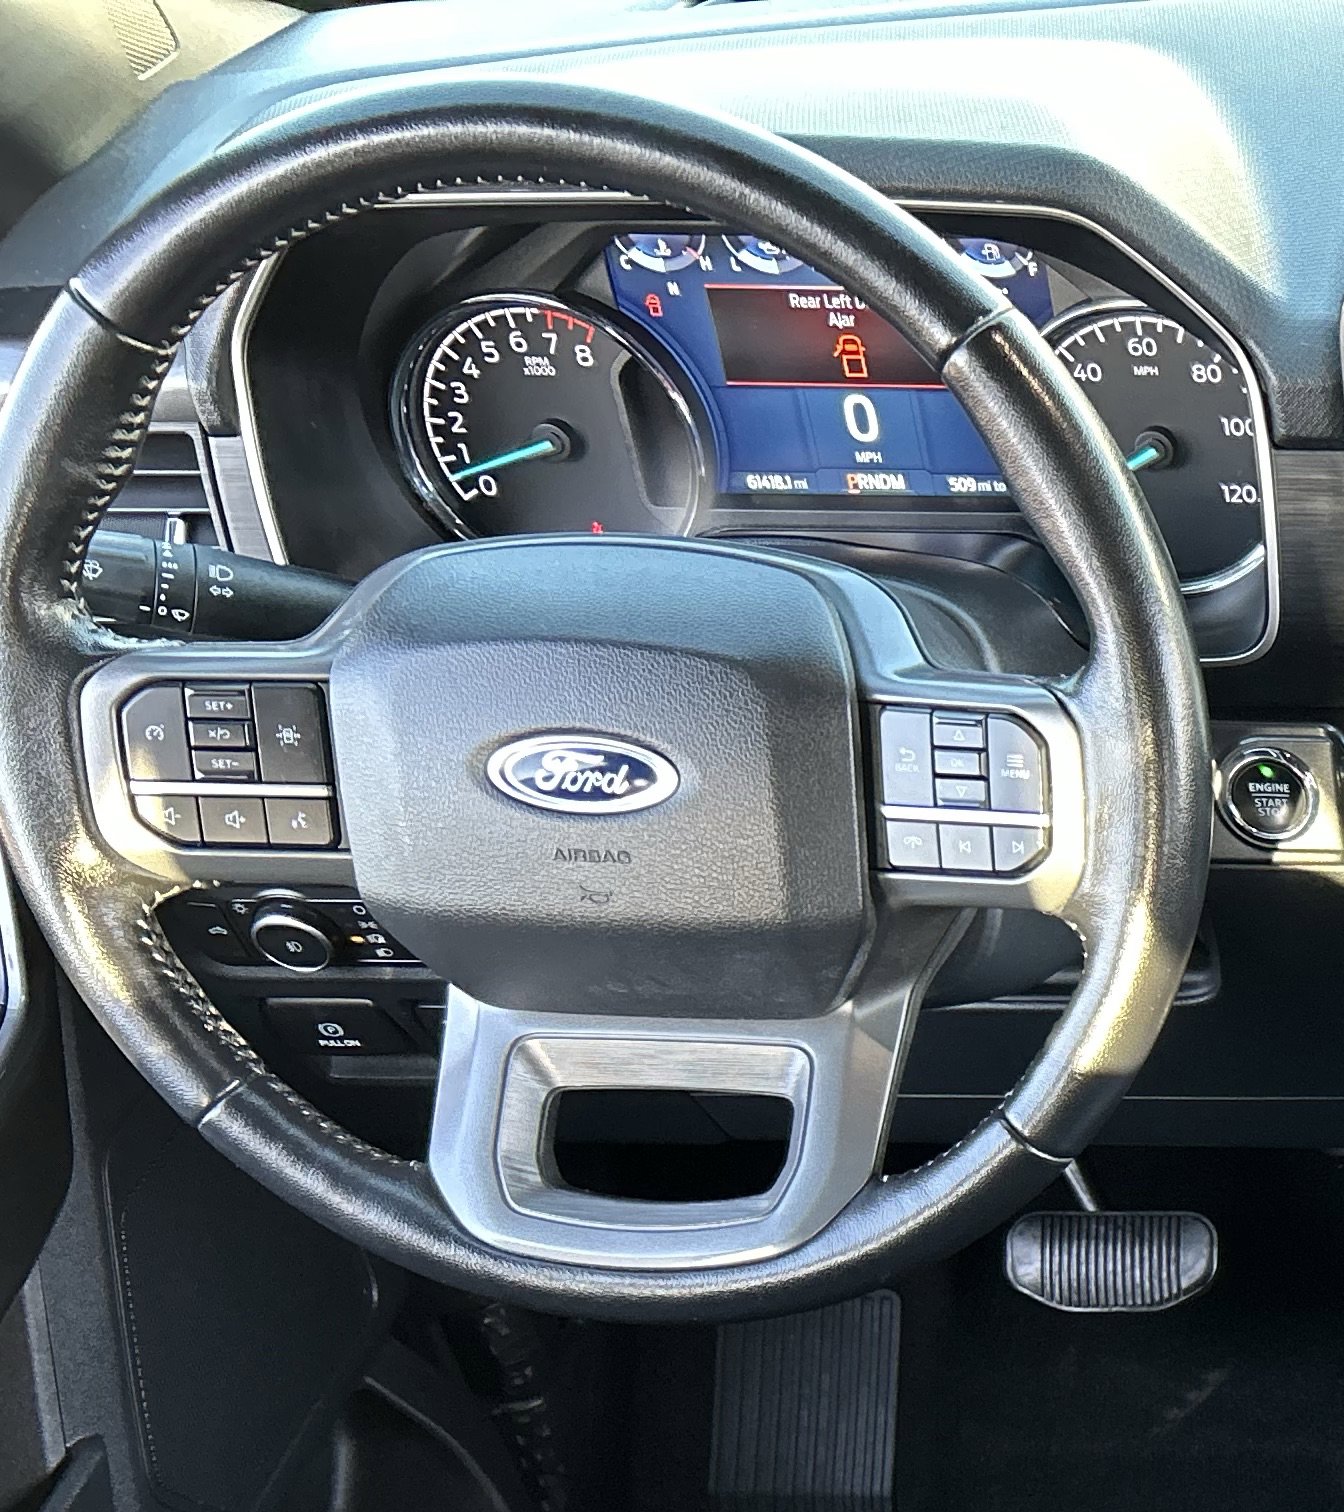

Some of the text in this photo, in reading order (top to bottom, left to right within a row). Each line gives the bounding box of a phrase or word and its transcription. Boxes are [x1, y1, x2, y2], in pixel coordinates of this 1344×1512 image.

[789, 293, 820, 309] Rear
[823, 293, 853, 309] Left
[829, 311, 855, 329] Ajar
[509, 331, 528, 352] 6
[542, 332, 558, 354] 7
[1127, 337, 1158, 357] 60
[480, 341, 500, 363] 5
[523, 355, 550, 367] RPM
[574, 344, 594, 367] 8
[462, 357, 481, 379] 4
[523, 366, 556, 377] x1000
[1073, 363, 1103, 382] 40
[1133, 366, 1159, 376] MPH
[1191, 363, 1222, 384] 80
[450, 381, 470, 404] 3
[447, 411, 467, 433] 2
[843, 394, 879, 443] 0
[457, 442, 471, 464] 1
[854, 451, 883, 464] MPH
[478, 474, 498, 496] 0
[1221, 485, 1257, 503] 120
[534, 750, 631, 795] Ford
[1248, 782, 1291, 793] ENGINE
[1254, 797, 1288, 808] START
[1257, 807, 1288, 817] STO
[552, 848, 633, 865] AIRBAG
